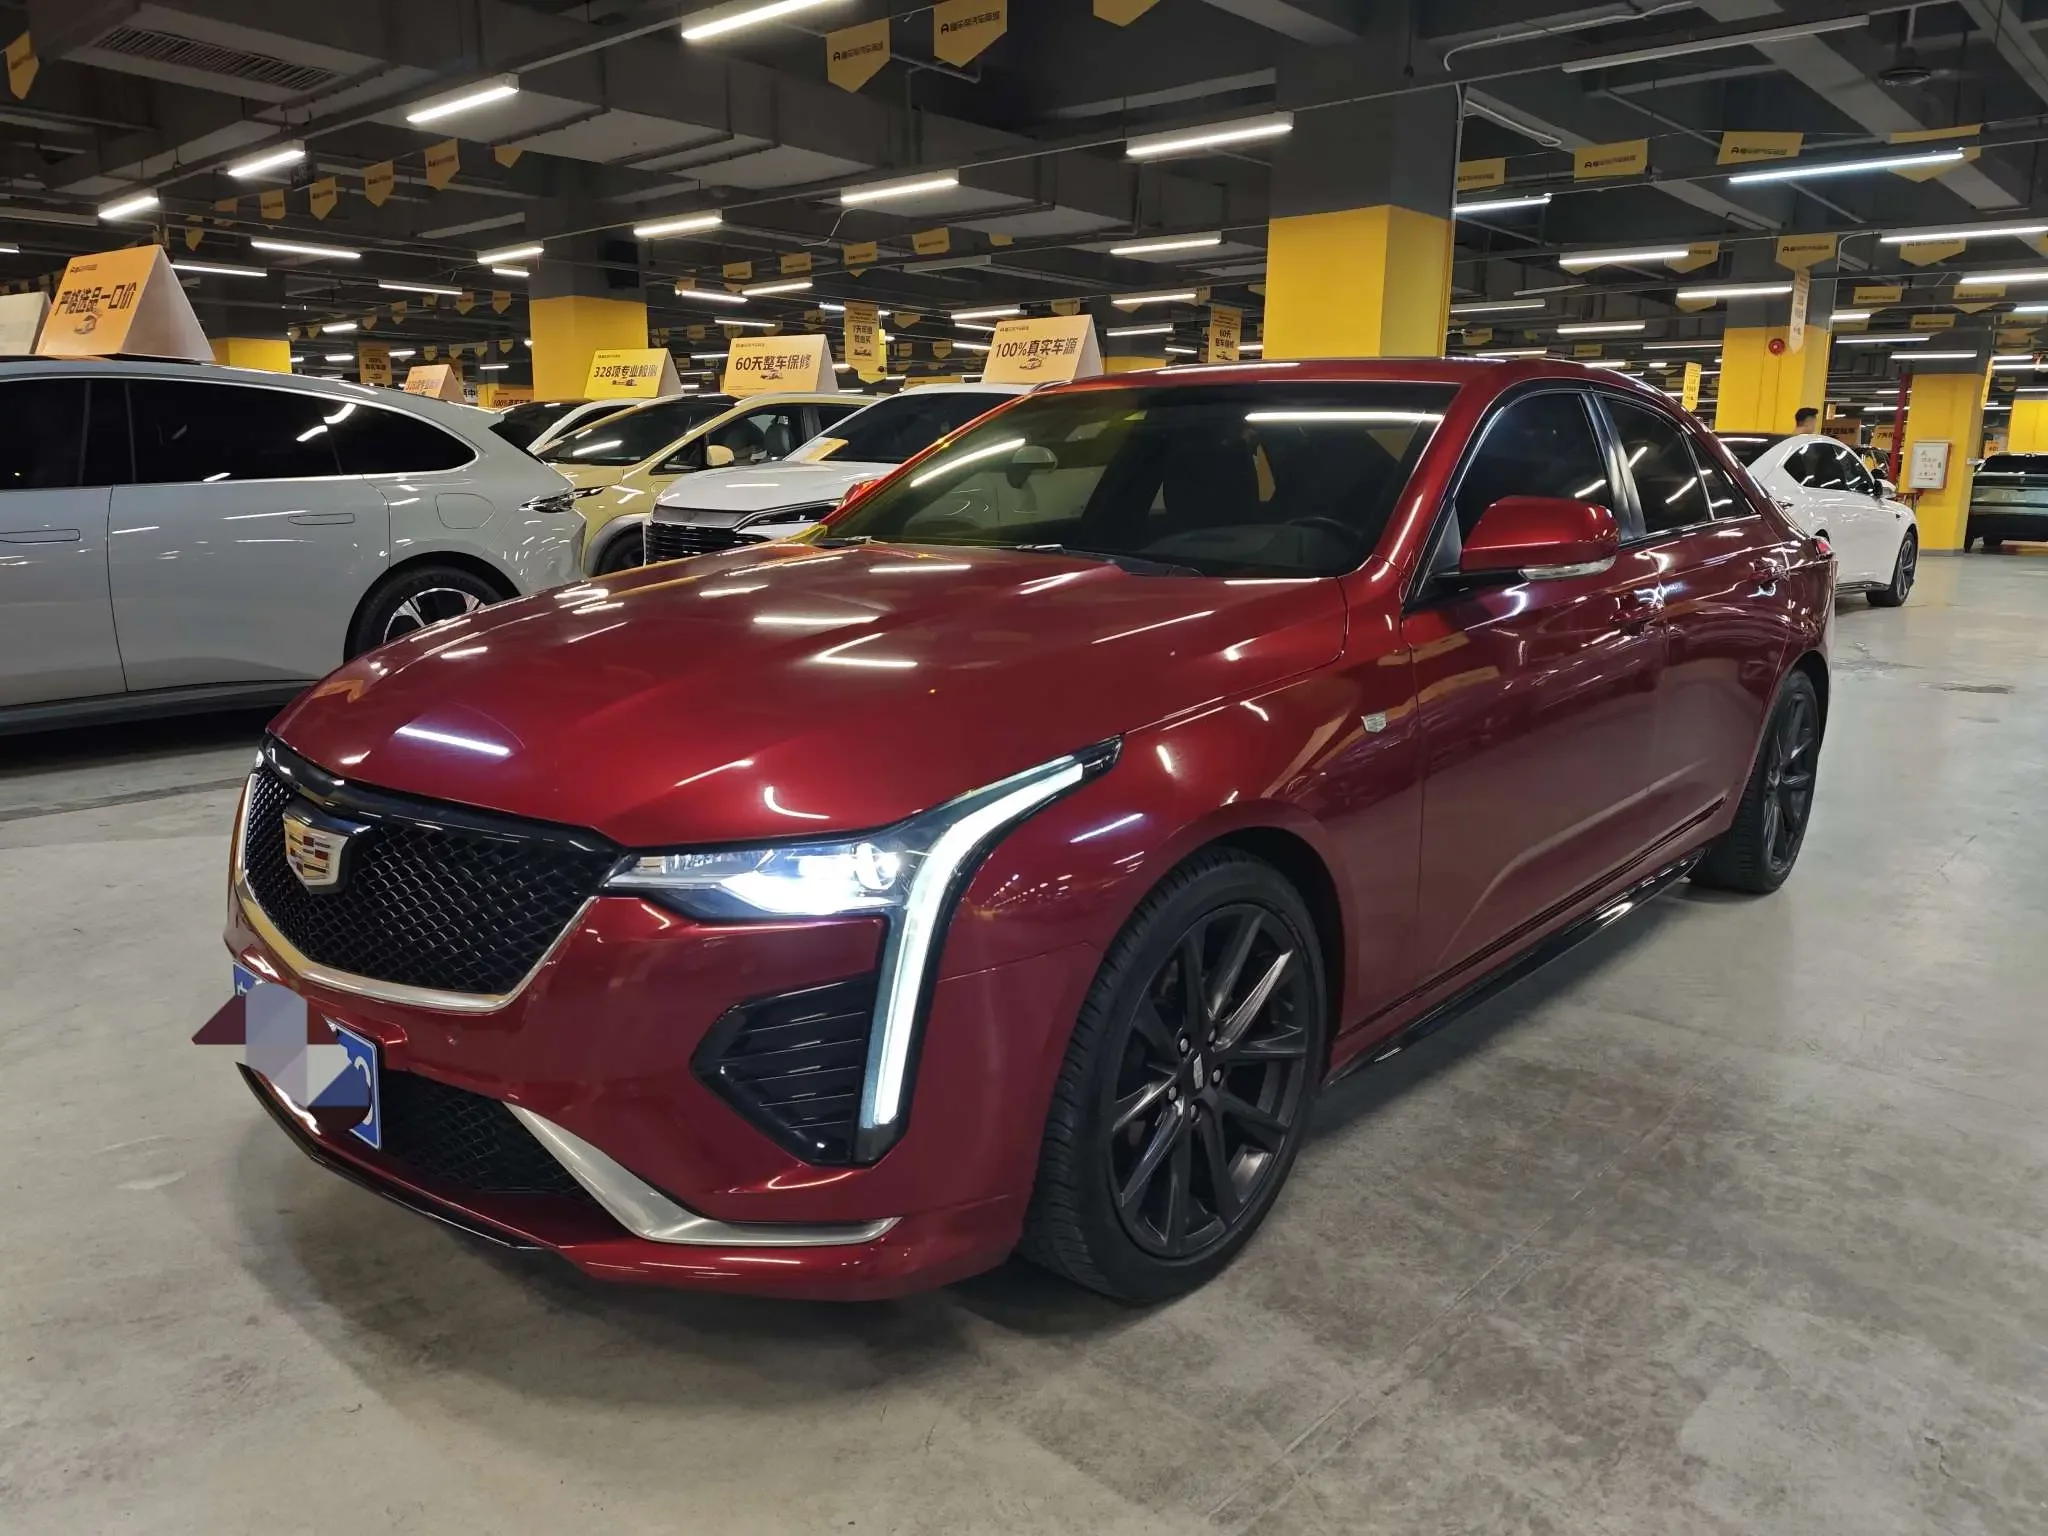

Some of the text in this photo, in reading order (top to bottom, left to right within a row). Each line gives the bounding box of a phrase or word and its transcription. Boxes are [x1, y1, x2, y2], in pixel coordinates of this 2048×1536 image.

[996, 337, 1079, 358] 100%真实车源
[735, 354, 812, 371] 60天整车保修
